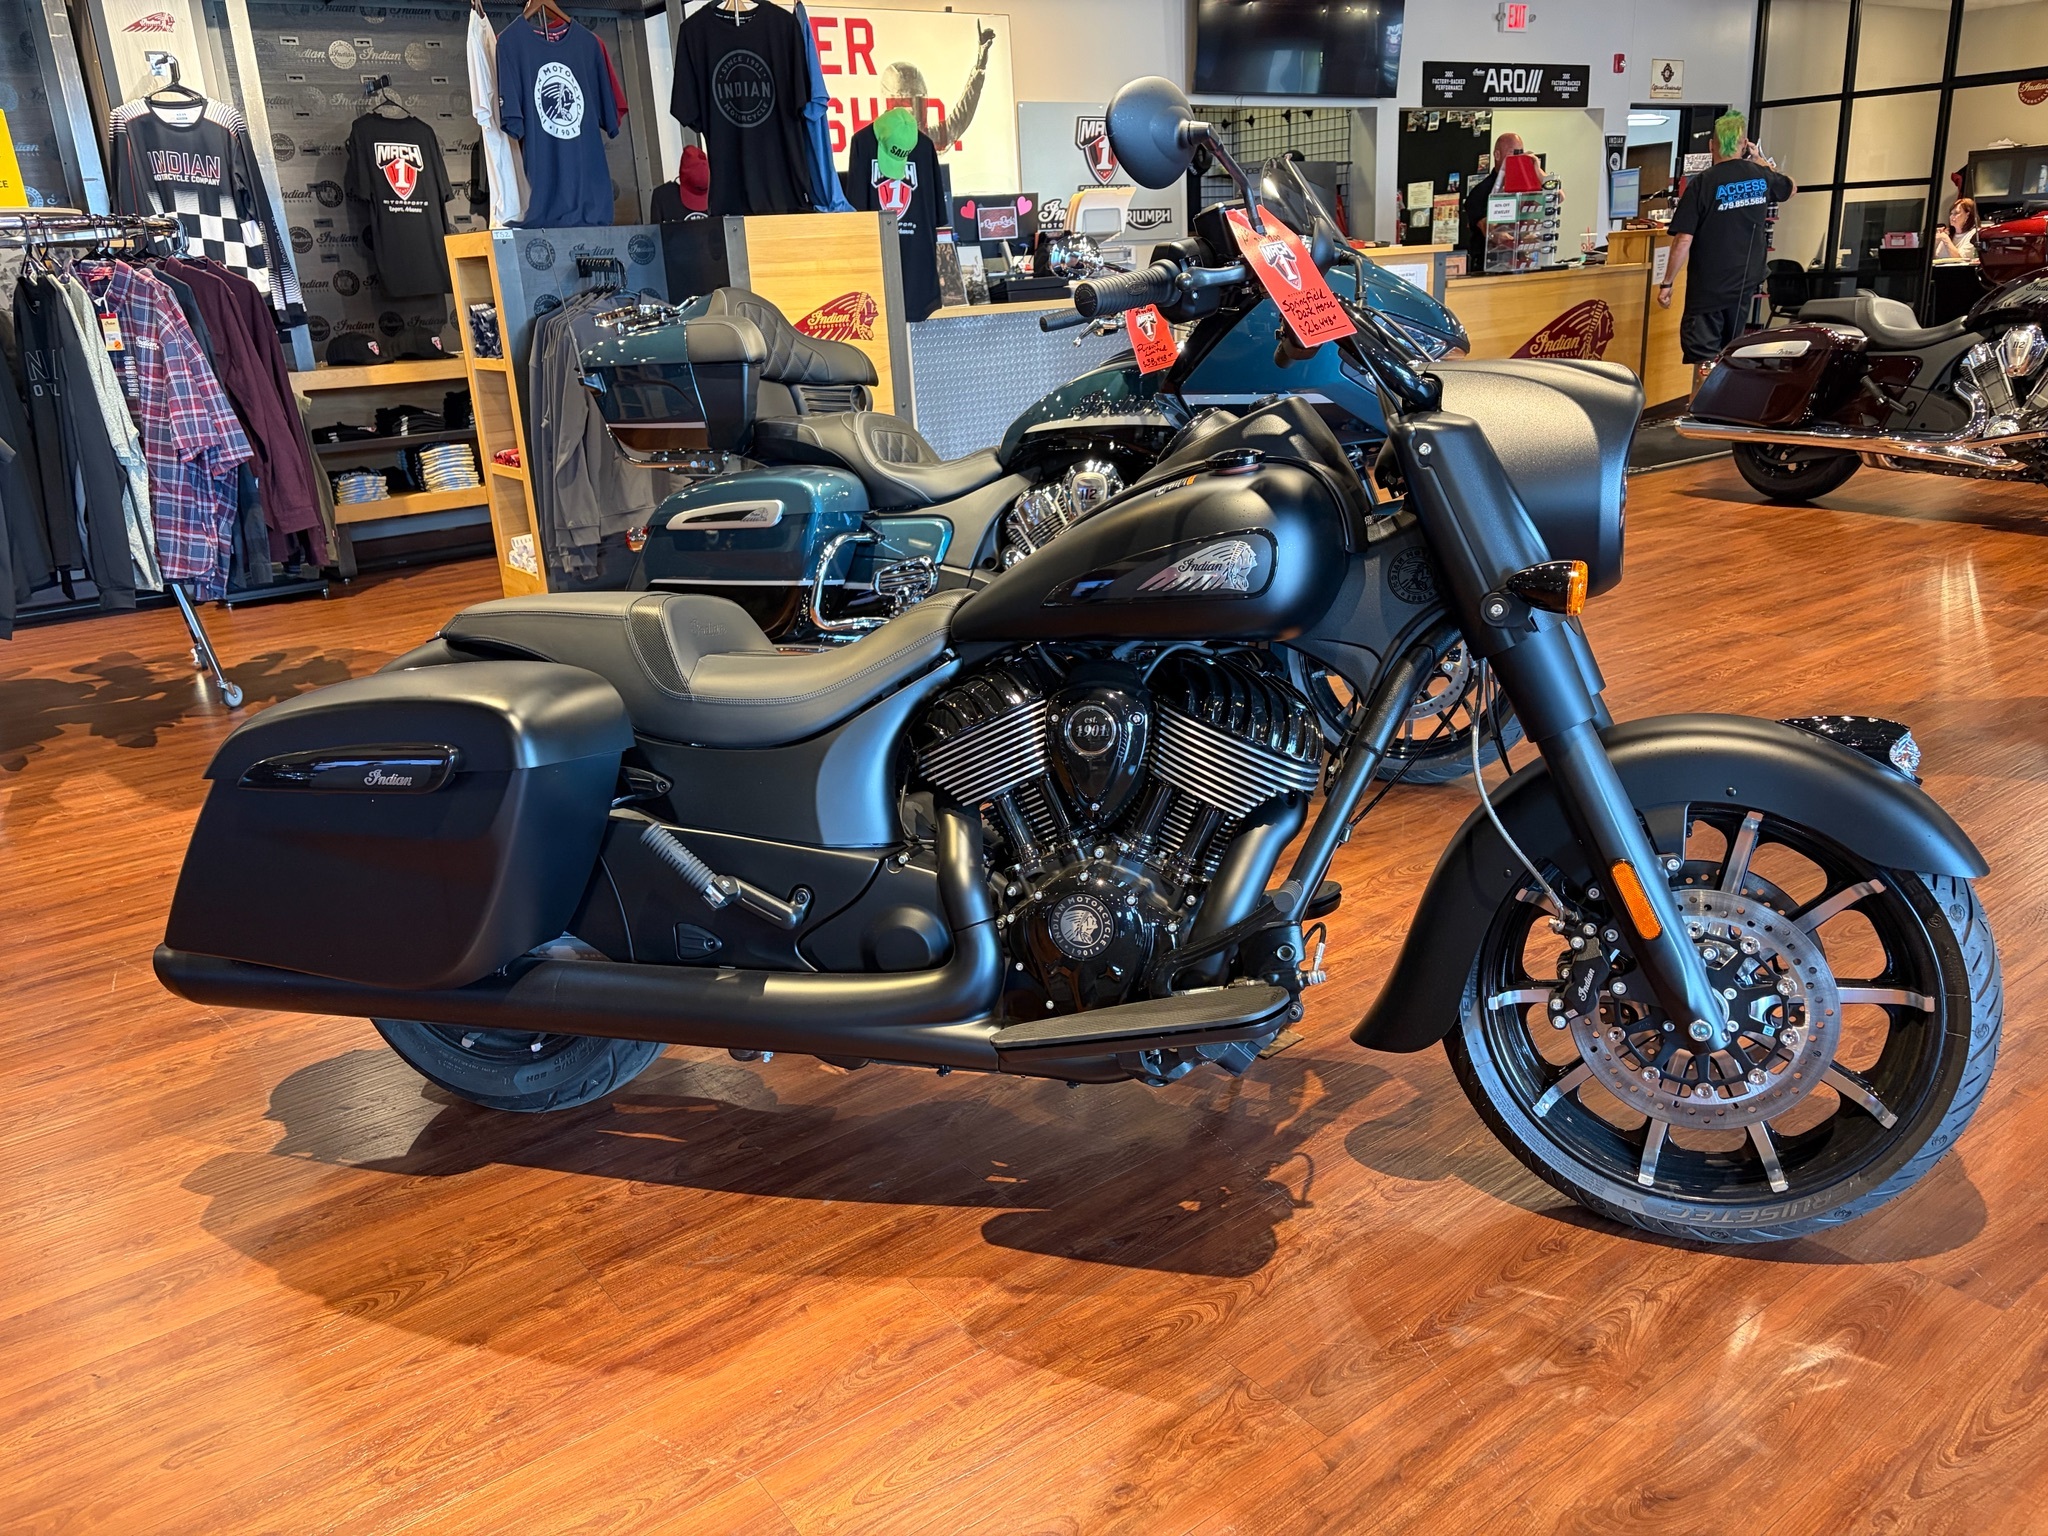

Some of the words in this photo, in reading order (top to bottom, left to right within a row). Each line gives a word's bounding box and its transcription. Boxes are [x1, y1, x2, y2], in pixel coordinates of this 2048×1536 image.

[1508, 4, 1527, 28] EXIT
[359, 47, 401, 60] Indian
[721, 55, 742, 74] SINCE
[746, 57, 763, 72] 1901
[717, 81, 771, 99] INDIAN
[723, 102, 769, 122] MOTORCYCLE
[555, 127, 576, 136] 1901
[377, 145, 422, 167] MACH
[1096, 136, 1113, 170] 1
[147, 150, 221, 179] INDIAN
[394, 158, 410, 188] 1
[190, 175, 221, 187] COMPANY
[1716, 179, 1768, 200] ACCESS
[1717, 196, 1767, 211] 479.855.5624
[316, 231, 359, 243] Indian
[333, 319, 375, 331] Indian
[807, 309, 850, 325] Indian
[1530, 331, 1580, 356] Indian
[1080, 489, 1097, 500] 112
[1177, 558, 1223, 574] Indian
[1084, 716, 1098, 724] est.
[1076, 724, 1107, 737] 1901
[364, 768, 412, 786] Indian
[1052, 903, 1066, 944] INDIAN
[1067, 896, 1111, 946] MOTORCYCLE
[1071, 948, 1094, 956] 1901
[1578, 967, 1595, 1002] Indian
[1665, 1182, 1851, 1224] CRUISETEC
